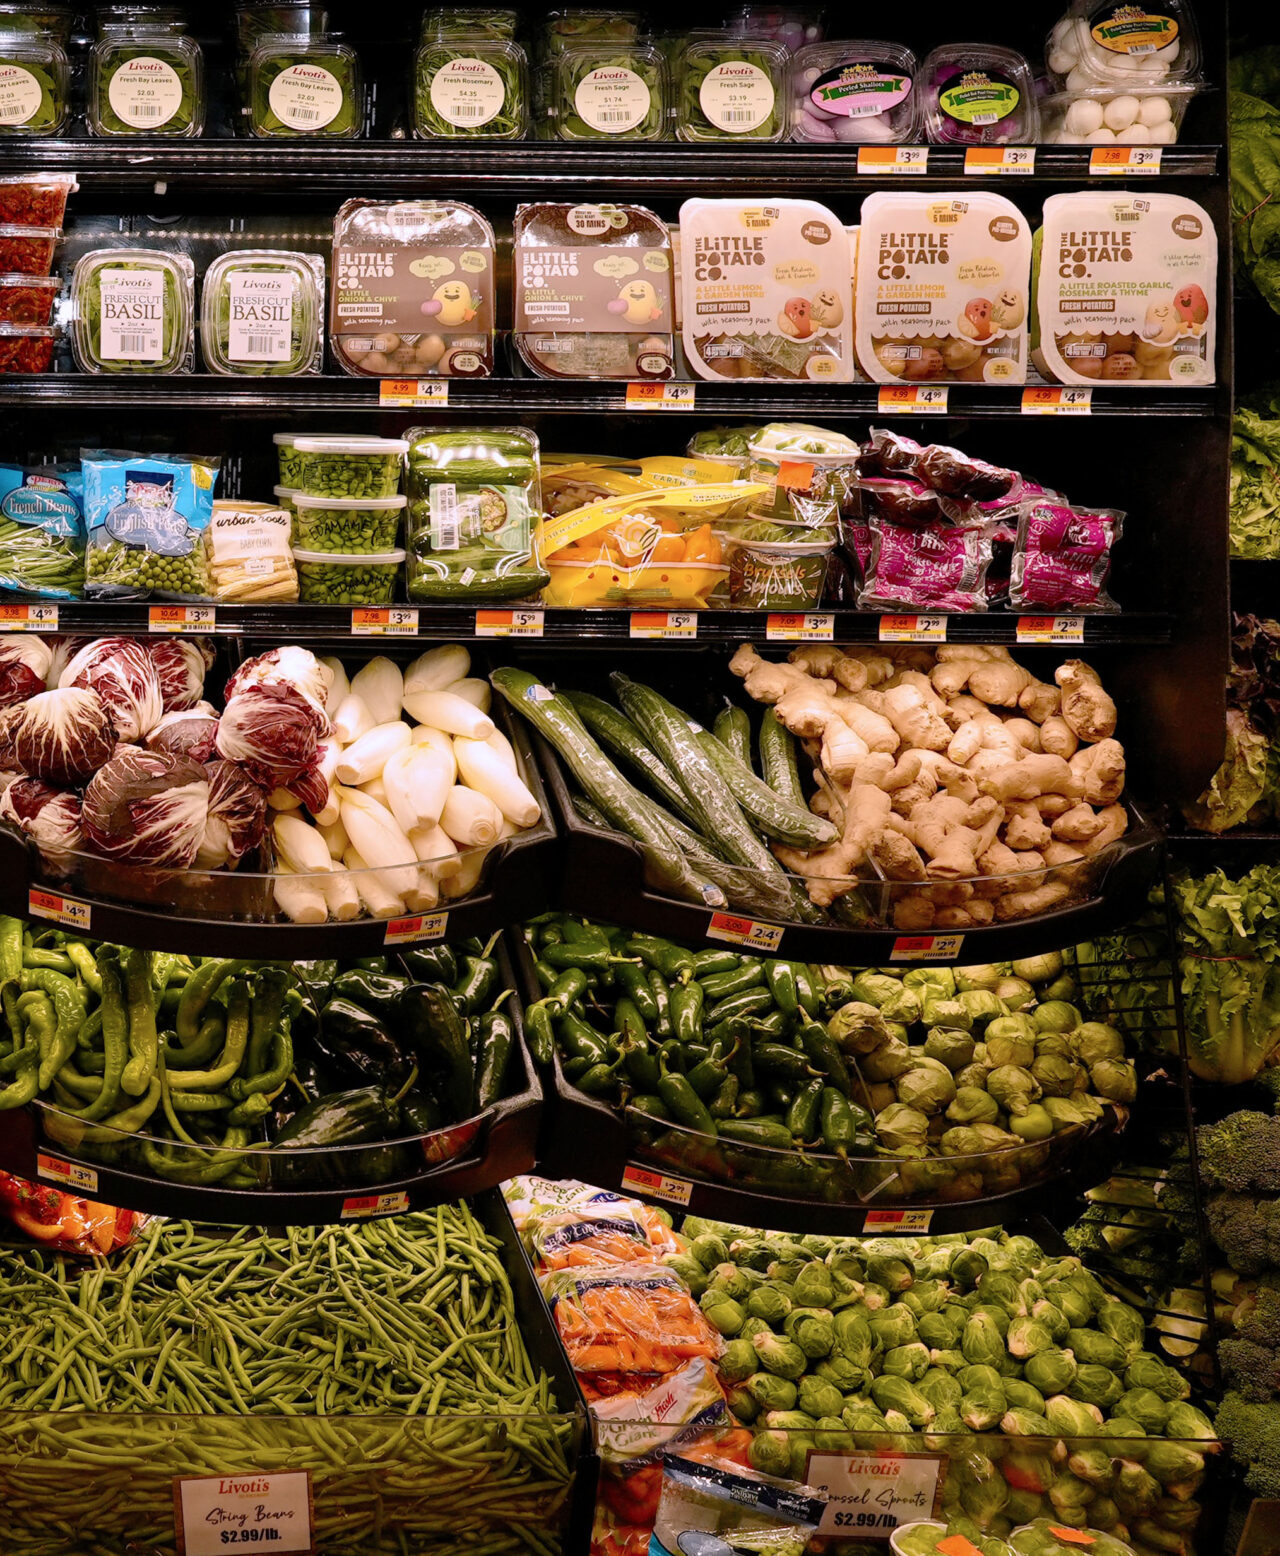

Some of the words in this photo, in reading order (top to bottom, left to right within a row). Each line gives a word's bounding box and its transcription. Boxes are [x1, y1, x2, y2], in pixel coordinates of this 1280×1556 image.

[120, 76, 136, 84] Fresh
[138, 76, 149, 86] Bay
[151, 76, 173, 85] Leaves
[282, 78, 298, 88] Fresh
[300, 81, 311, 91] Bay
[313, 83, 334, 93] Leaves
[443, 77, 459, 85] Fresh
[461, 77, 494, 87] Rosemary
[720, 81, 736, 89] Fresh
[738, 82, 755, 91] Sage
[837, 83, 857, 93] Peeled
[859, 80, 885, 90] Shallots
[746, 220, 751, 228] 5
[880, 233, 888, 248] THE
[1060, 232, 1068, 247] THE
[695, 252, 766, 266] POTATO
[879, 249, 949, 265] POTATO
[1059, 247, 1133, 264] POTATO
[338, 266, 394, 278] POTATO
[523, 264, 579, 278] POTATO
[695, 267, 727, 282] CO.
[878, 265, 910, 281] CO.
[1059, 264, 1092, 278] CO.
[337, 278, 363, 290] CO.
[523, 276, 549, 288] CO.
[732, 284, 762, 292] LEMON
[1097, 282, 1137, 290] ROASTED
[104, 294, 136, 304] FRESH
[138, 295, 162, 305] CUT
[233, 296, 264, 306] FRESH
[266, 296, 291, 306] CUT
[696, 292, 702, 300] &
[704, 292, 736, 300] GARDEN
[104, 304, 162, 320] BASIL
[698, 303, 718, 312] FRESH
[719, 302, 749, 312] POTATOES
[878, 304, 900, 314] FRESH
[901, 304, 929, 314] POTATOES
[1062, 301, 1081, 311] FRESH
[1082, 300, 1114, 310] POTATOES
[233, 306, 291, 322] BASIL
[10, 498, 42, 514] French
[309, 518, 370, 538] EDAMAME
[218, 1478, 270, 1495] Livoti's
[205, 1507, 249, 1528] String
[254, 1504, 296, 1522] Beans
[220, 1528, 282, 1544] $2.99/lb.
